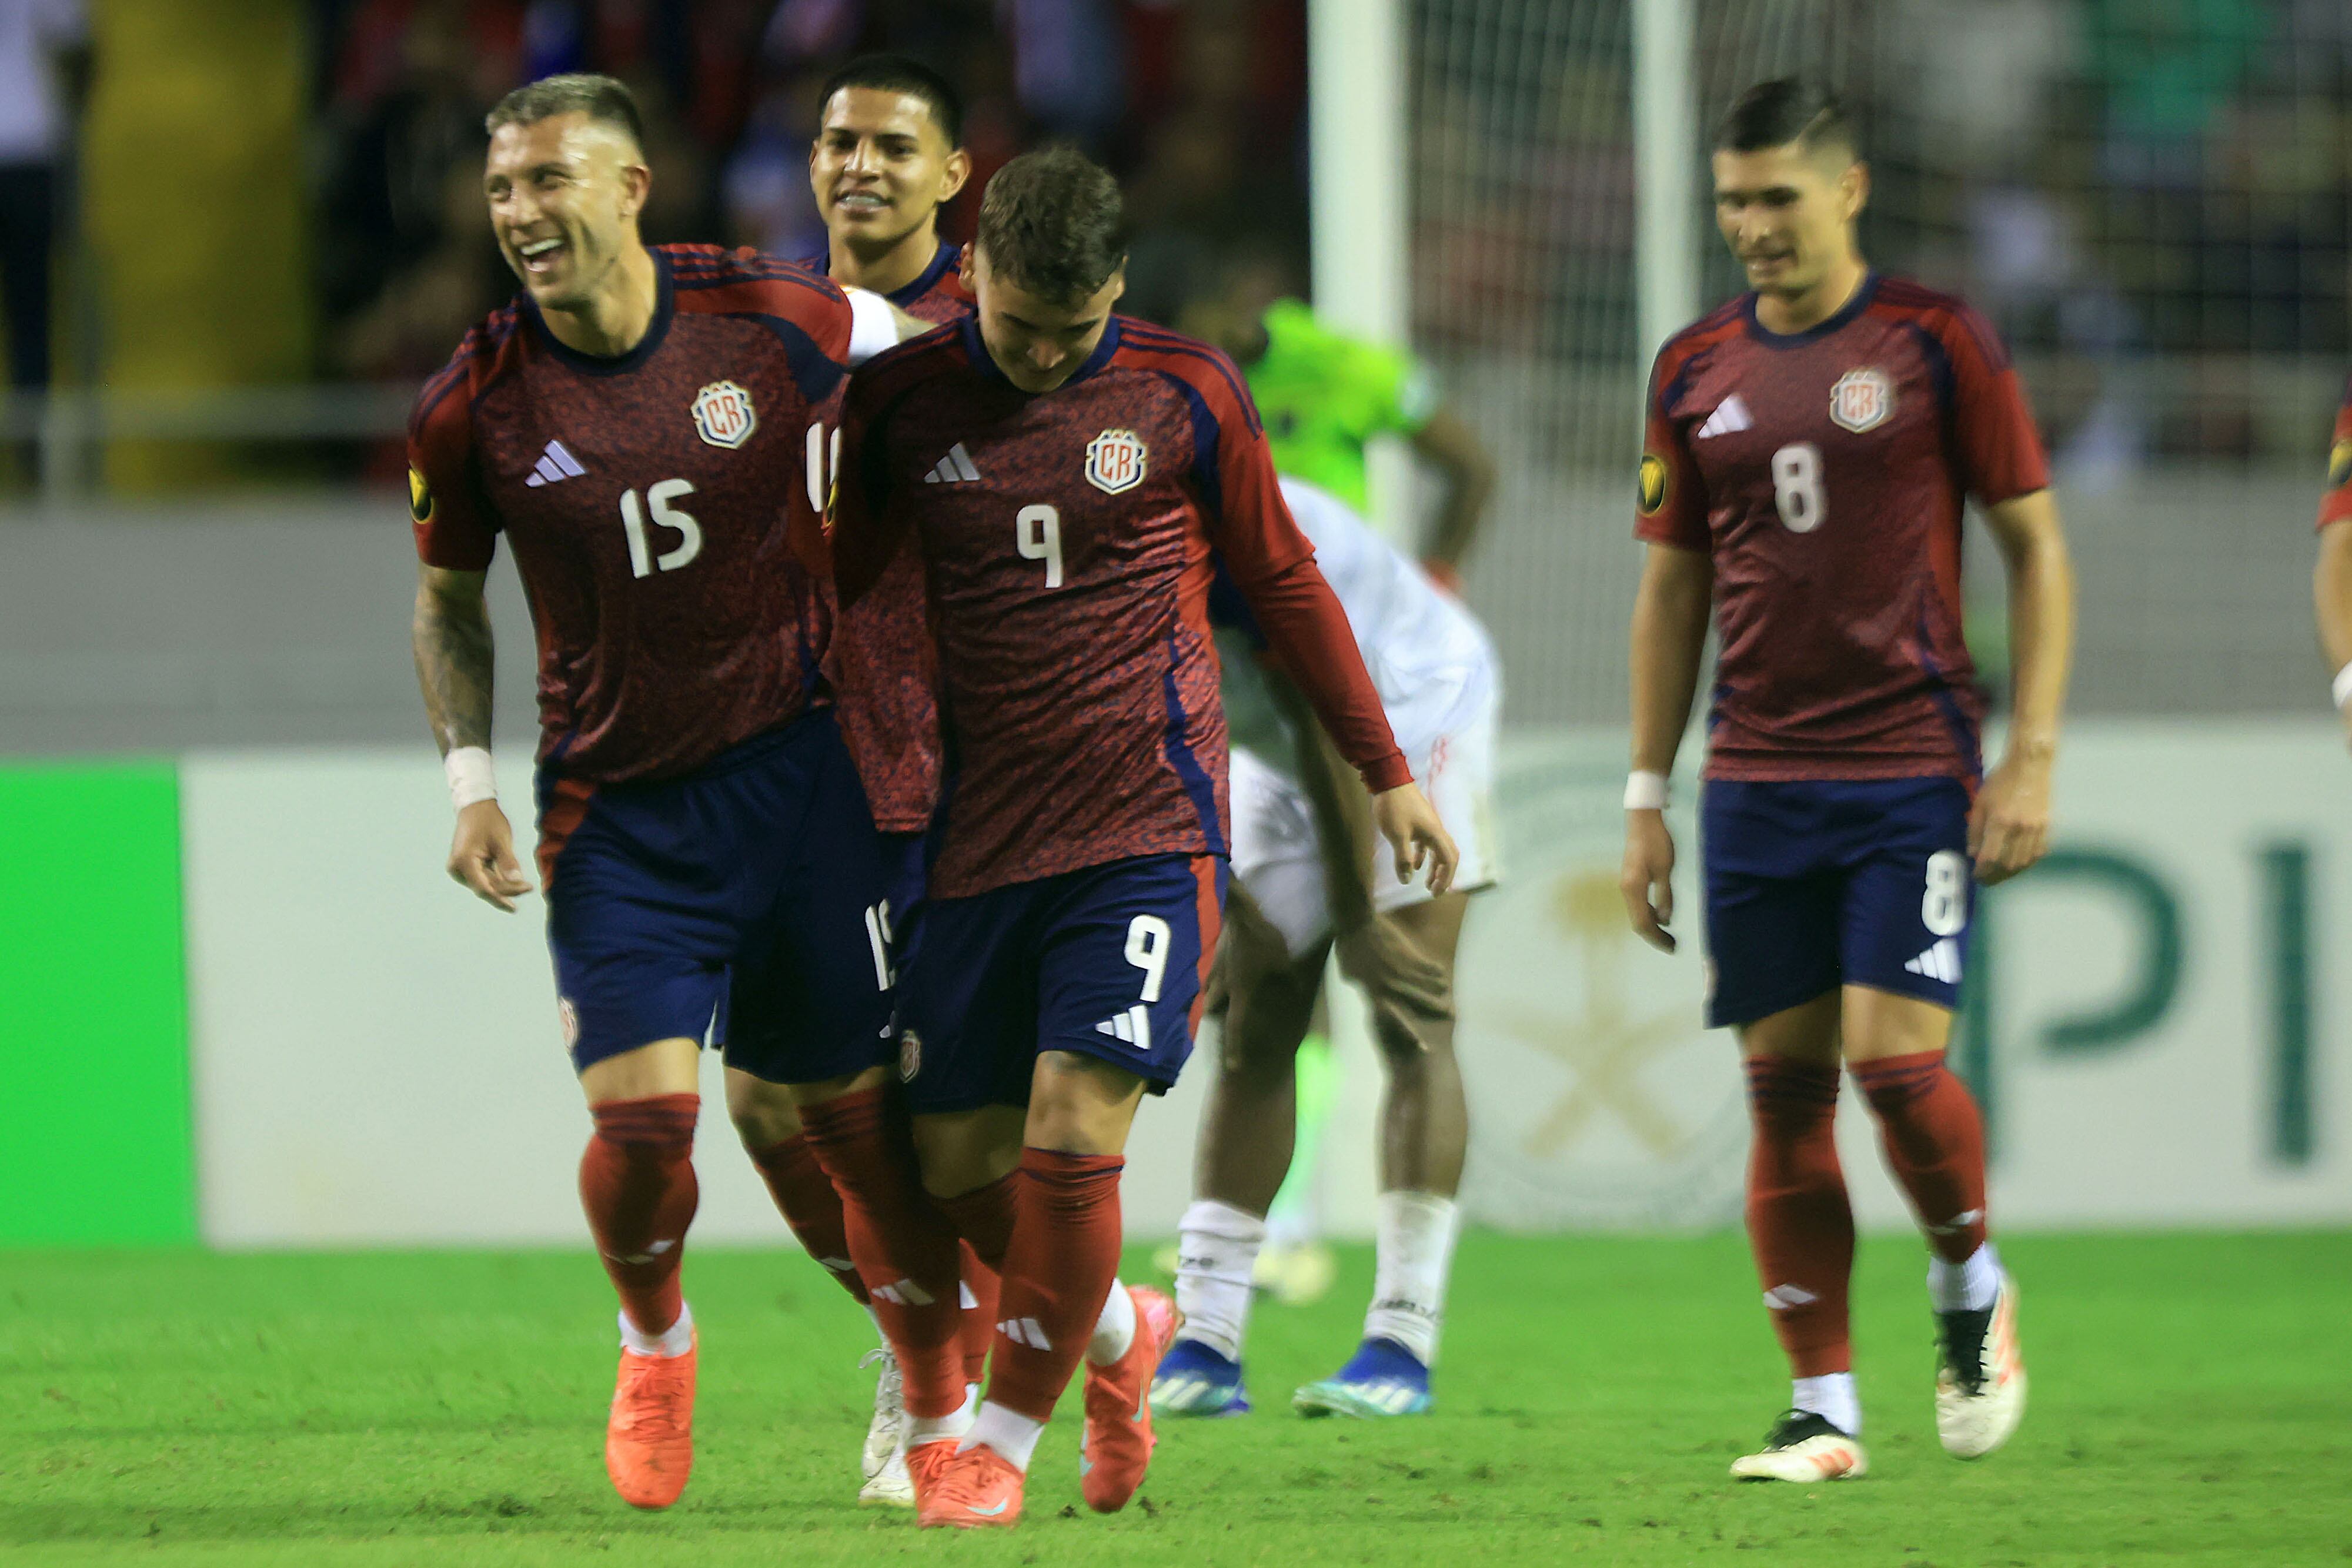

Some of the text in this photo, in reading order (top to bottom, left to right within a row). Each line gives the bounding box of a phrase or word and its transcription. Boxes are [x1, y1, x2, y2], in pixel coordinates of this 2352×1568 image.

[706, 394, 742, 435] CR
[1100, 443, 1132, 481] CR
[1771, 444, 1825, 533] 8
[619, 479, 703, 580] 15
[1016, 504, 1064, 589] 9
[1921, 850, 1968, 936] 8
[1124, 914, 1171, 1002] 9
